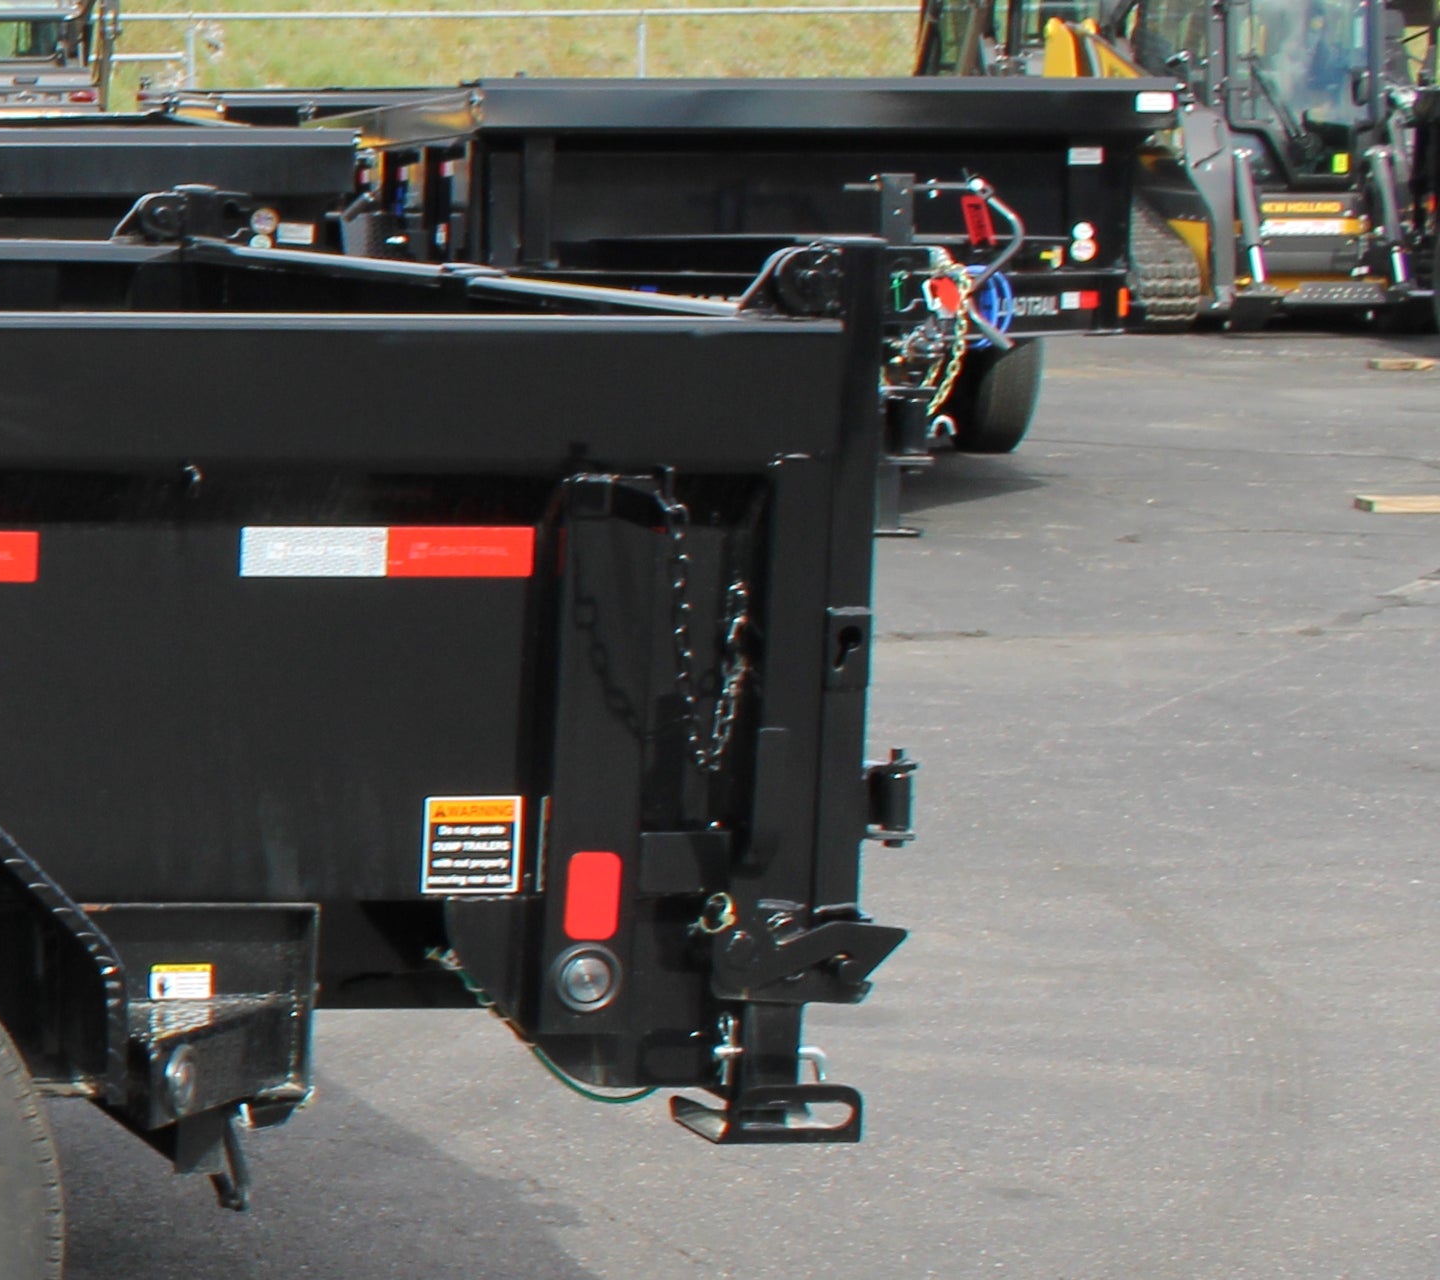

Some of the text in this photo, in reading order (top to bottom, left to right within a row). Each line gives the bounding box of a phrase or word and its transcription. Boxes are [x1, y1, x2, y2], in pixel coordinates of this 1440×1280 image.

[1288, 201, 1343, 213] HOLLAND
[286, 546, 368, 557] LOAD TRAIL
[430, 546, 510, 557] LOAD TRAIL
[447, 805, 513, 817] WARNING
[438, 825, 507, 837] Do not operate
[432, 841, 511, 852] DUMP TRAILERS
[469, 857, 510, 869] properly
